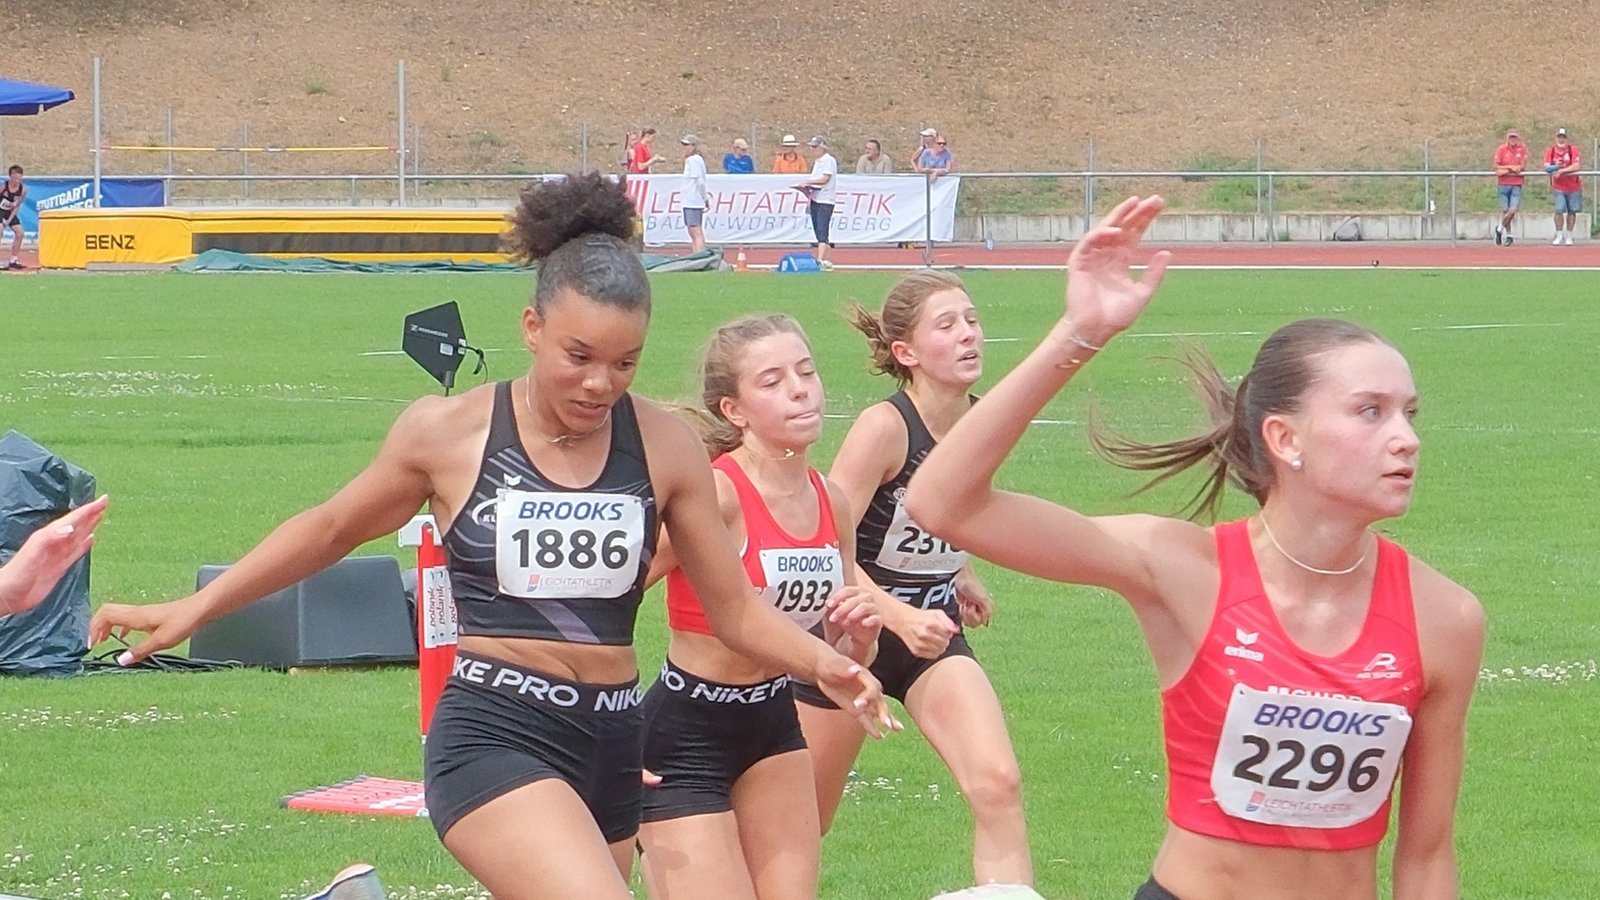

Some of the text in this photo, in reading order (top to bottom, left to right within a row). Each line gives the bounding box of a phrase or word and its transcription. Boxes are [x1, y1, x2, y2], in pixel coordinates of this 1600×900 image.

[36, 183, 90, 210] STUTTGART
[85, 235, 135, 250] BENZ
[518, 501, 624, 521] BROOKS
[511, 528, 629, 570] 1886
[777, 555, 834, 573] BROOKS
[774, 579, 833, 613] 1933
[491, 668, 580, 707] PRO
[690, 683, 771, 704] NIKE
[1254, 702, 1390, 737] BROOKS
[1232, 734, 1385, 793] 2296
